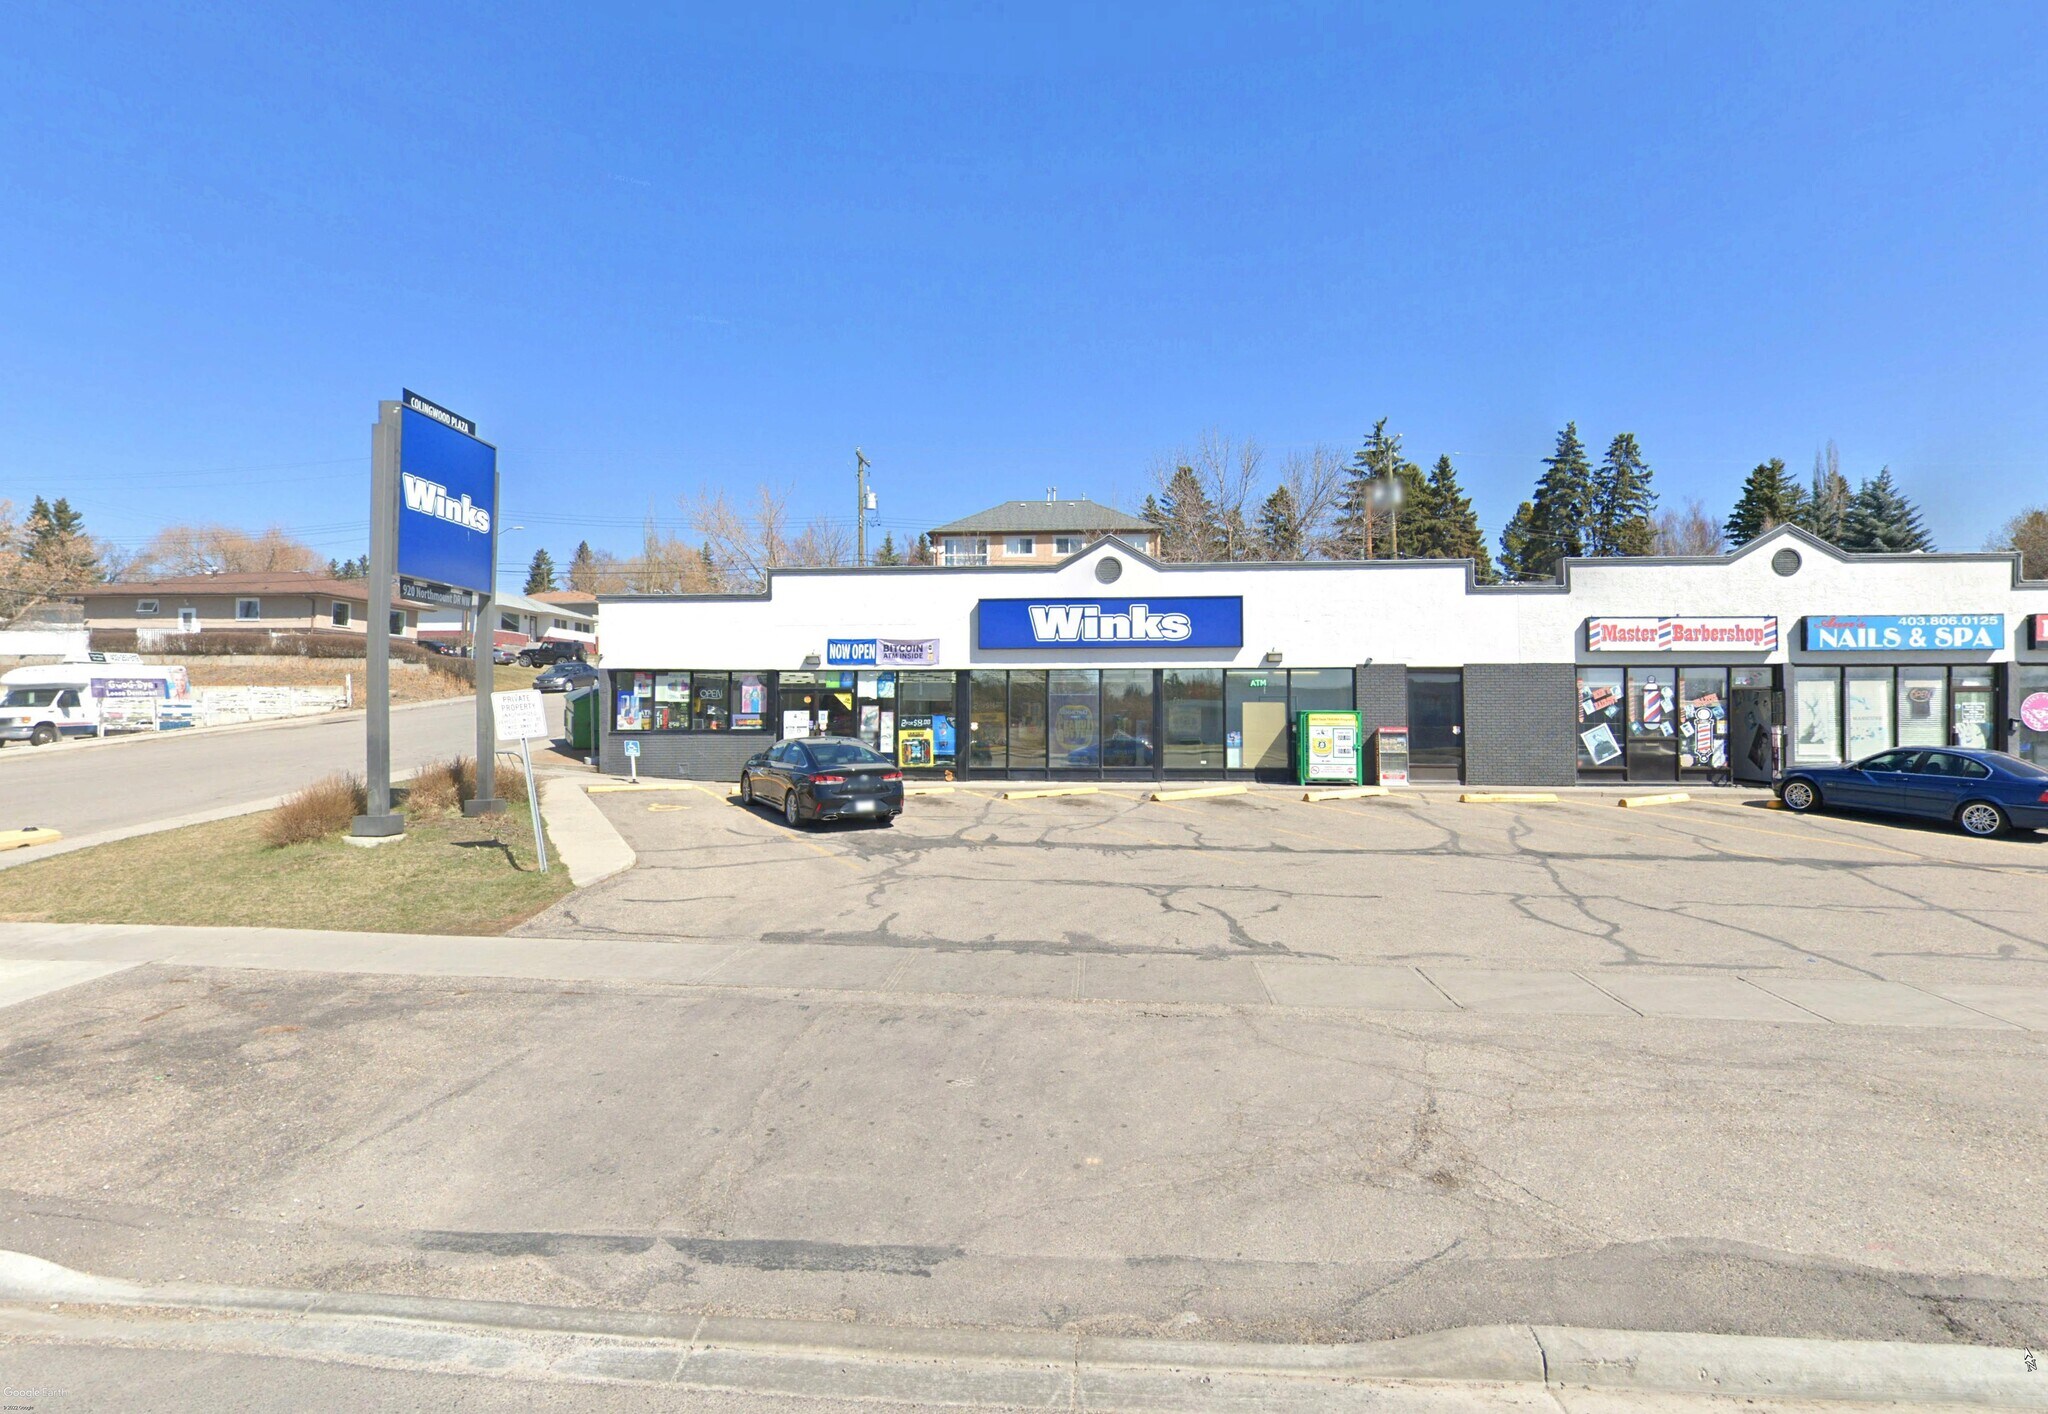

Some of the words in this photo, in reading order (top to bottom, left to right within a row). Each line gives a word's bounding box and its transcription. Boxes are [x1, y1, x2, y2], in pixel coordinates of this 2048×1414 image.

[451, 416, 469, 433] PLAZA
[403, 473, 490, 533] Winks
[403, 584, 416, 597] 920
[1029, 604, 1192, 641] Winks
[1898, 615, 1999, 626] 403.806.0125
[1601, 625, 1658, 642] Master
[1671, 624, 1764, 645] Barbershop
[1819, 627, 1902, 648] NAILS
[1908, 627, 1927, 648] &
[1934, 627, 1993, 647] SPA
[829, 643, 850, 660] NOW
[851, 643, 876, 660] OPEN
[883, 644, 923, 653] BITCOIN
[1250, 679, 1267, 687] ATM
[502, 694, 530, 702] PRIVATE
[700, 689, 723, 698] OPEN
[501, 703, 535, 711] PROPERTY
[901, 719, 907, 727] 2
